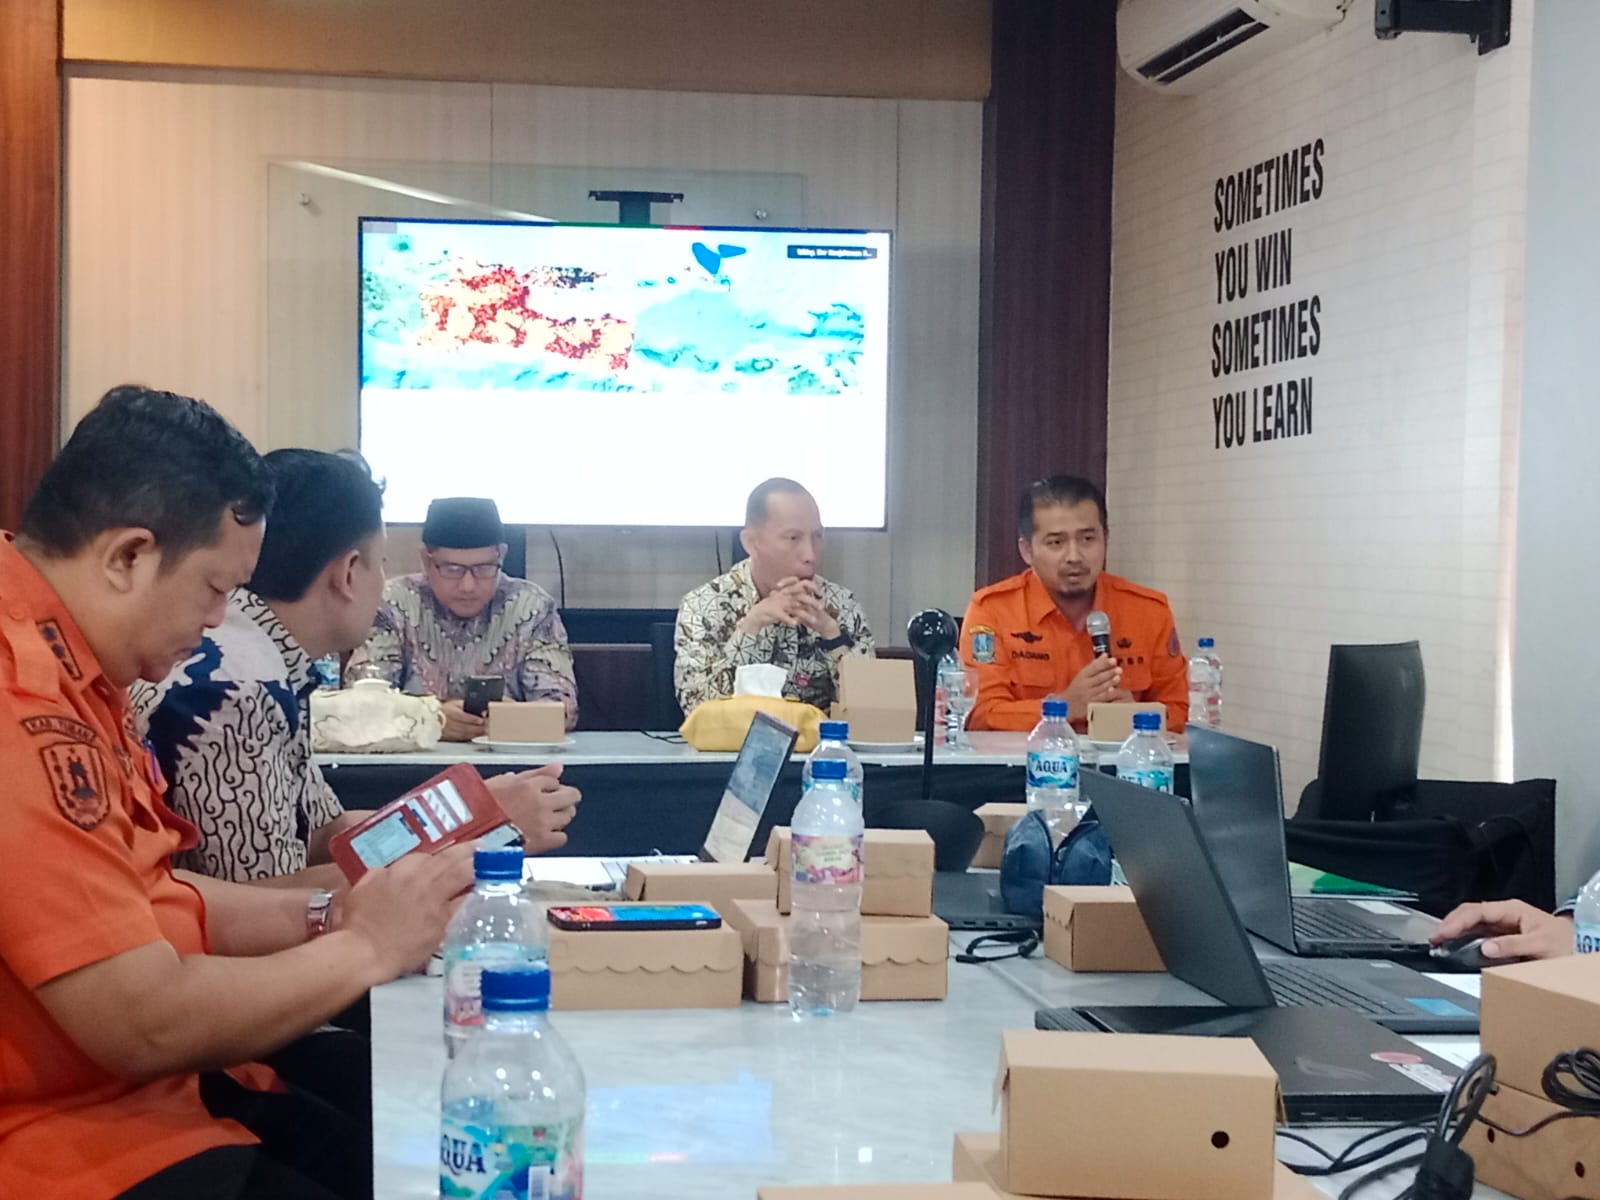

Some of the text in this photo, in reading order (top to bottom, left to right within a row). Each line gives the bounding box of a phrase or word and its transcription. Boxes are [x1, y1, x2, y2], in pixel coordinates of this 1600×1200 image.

[1214, 138, 1324, 233] SOMETIMES
[1215, 228, 1292, 304] YOU WIN
[1211, 295, 1321, 378] SOMETIMES
[1212, 376, 1312, 449] YOU LEARN
[1035, 759, 1068, 775] AQUA
